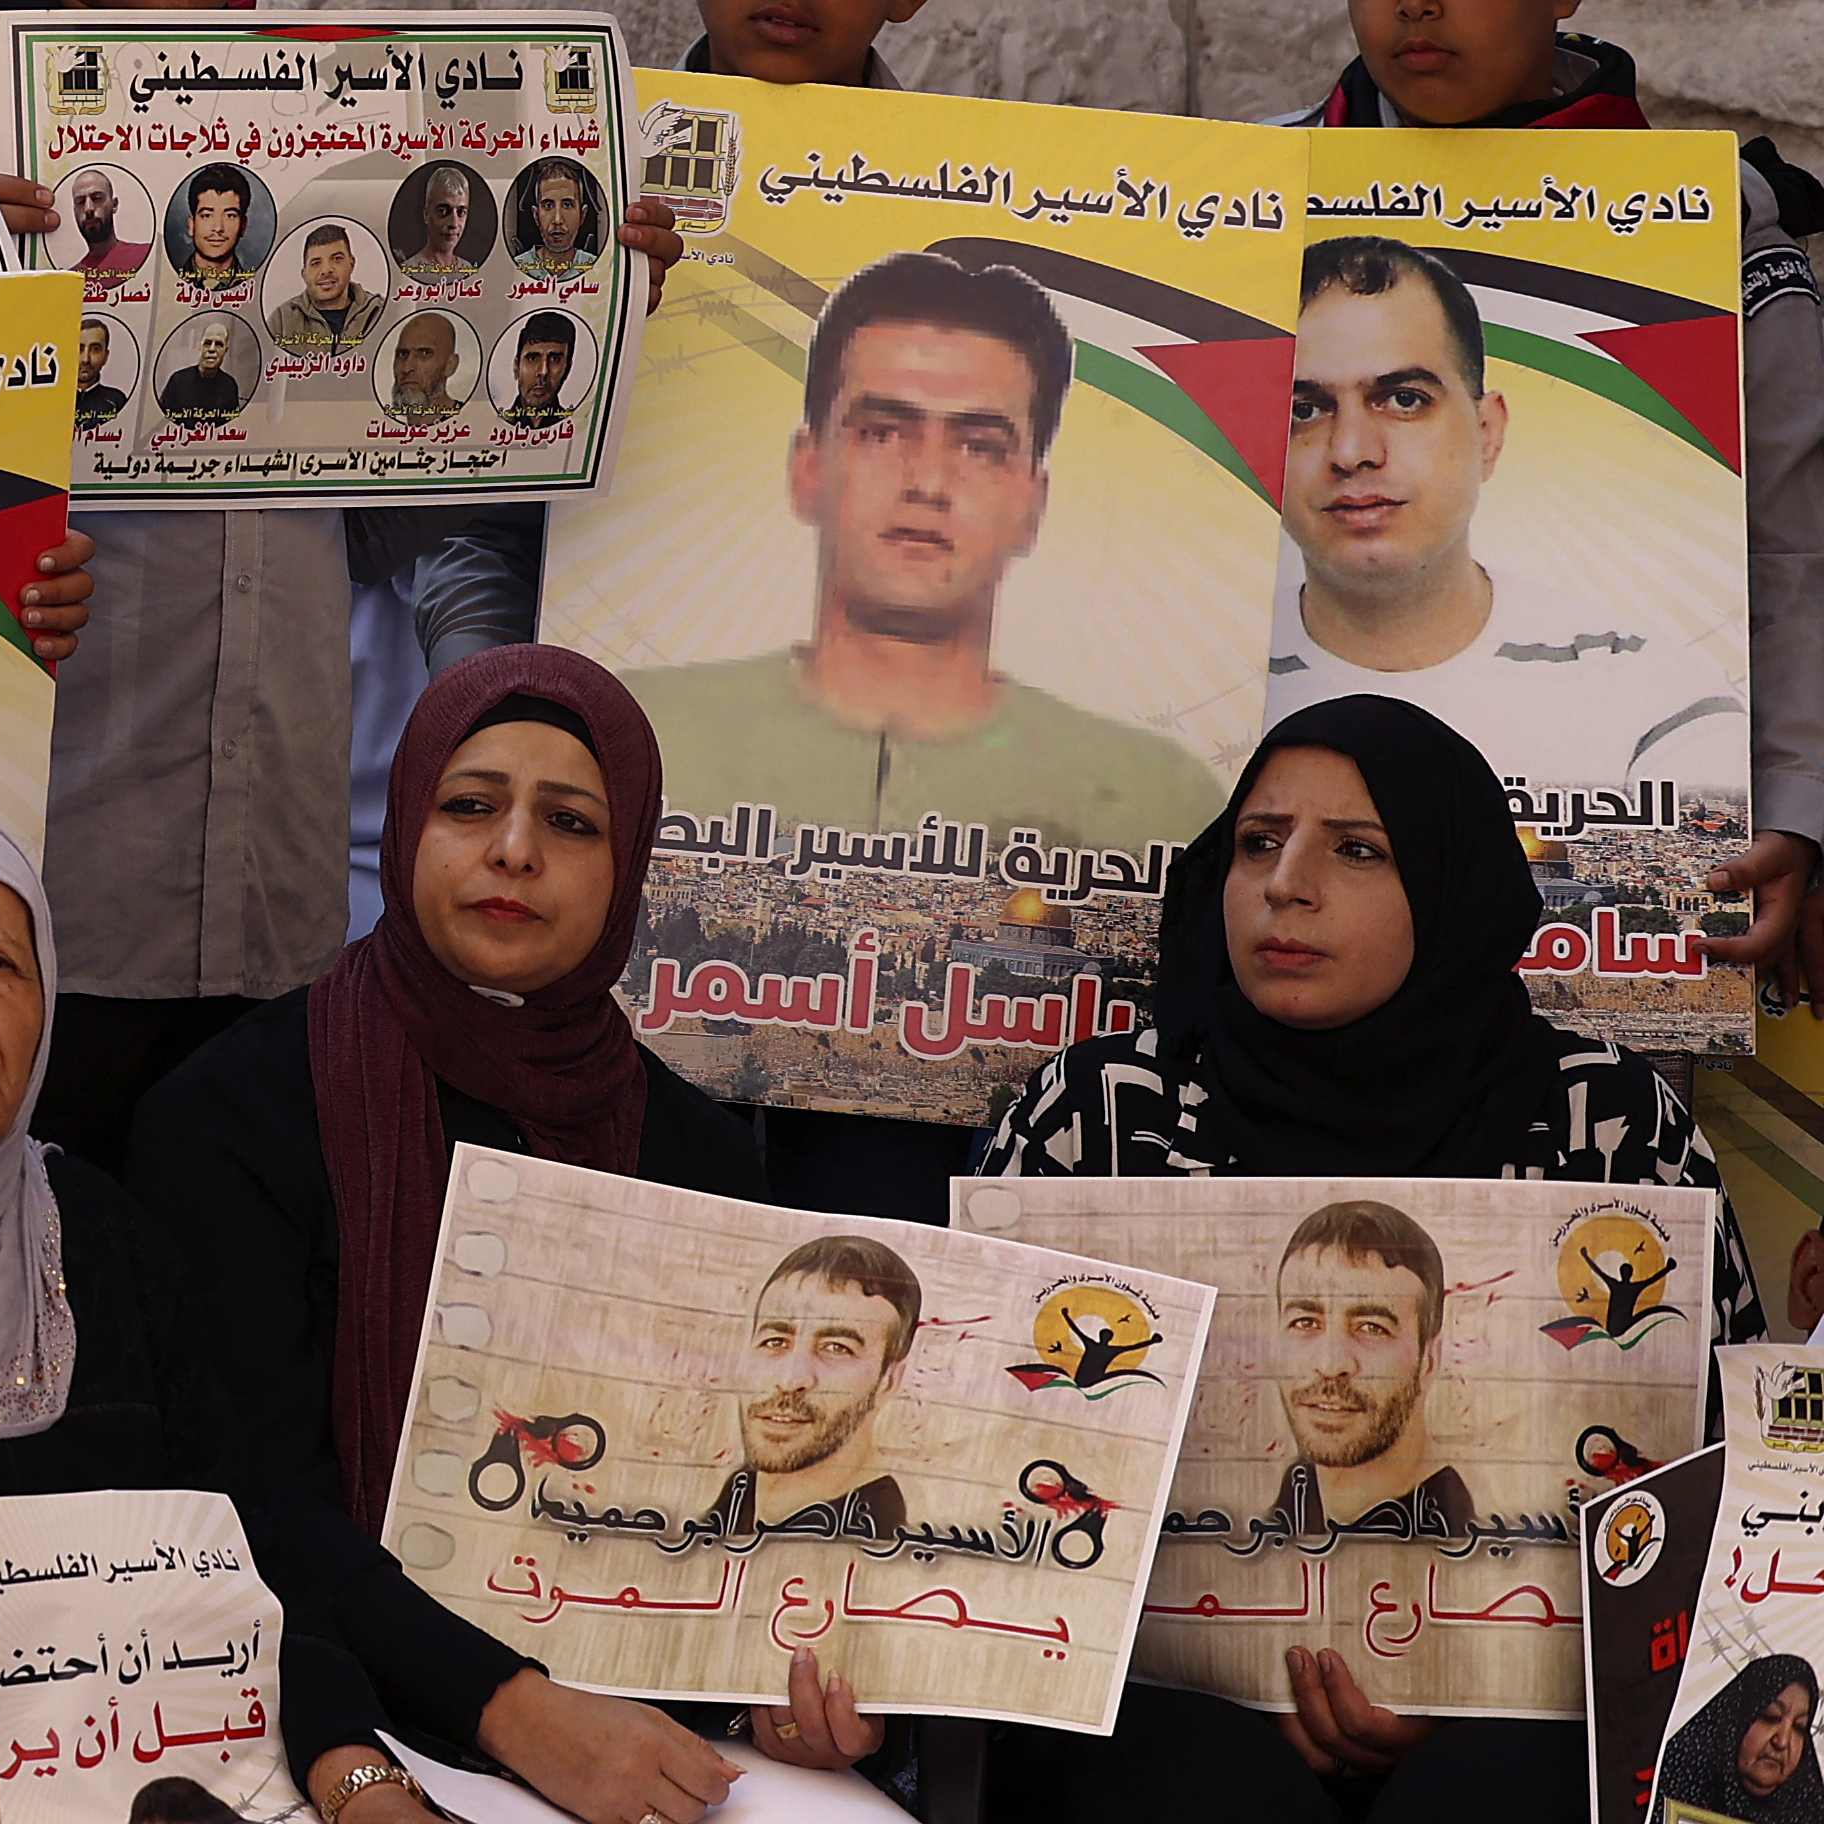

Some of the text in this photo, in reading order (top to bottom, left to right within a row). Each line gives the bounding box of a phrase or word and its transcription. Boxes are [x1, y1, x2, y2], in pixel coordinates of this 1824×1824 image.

[130, 44, 523, 113] نادي الأسير الفلسطيني
[49, 117, 600, 164] شهداء الحركة الأسيرة المحتجزون في ثلاجات الاحتلال
[759, 152, 1286, 239] نادي الأسير الفلسطيني
[1445, 176, 1595, 227] الأسير
[1608, 187, 1711, 234] نادي
[707, 254, 734, 265] نادي
[176, 282, 210, 308] دولة
[447, 280, 483, 301] كمال
[559, 276, 599, 304] سامي
[266, 352, 365, 381] داود الزبيدي
[85, 425, 122, 448] بسام
[217, 426, 247, 441] سعد
[430, 420, 471, 443] عزيز
[490, 420, 574, 446] فارس بارود
[94, 447, 507, 480] احتجاز جثامين الأسرى الشهداء جريمة دولية
[1505, 776, 1674, 836] الحرية
[794, 813, 985, 881] للأسير
[640, 930, 878, 1032] أسمر
[656, 1471, 750, 1555] أبو
[729, 1490, 880, 1554] ناصر
[1240, 1462, 1307, 1560] أبو
[1312, 1489, 1451, 1554] ناصر
[1741, 1491, 1824, 1537] بني
[103, 1539, 186, 1584] الأسير
[192, 1546, 240, 1579] نادي
[486, 1555, 1071, 1662] يصارع الموت
[119, 1628, 150, 1686] أن
[162, 1619, 261, 1677] أريد
[75, 1696, 120, 1769] أن
[133, 1686, 267, 1764] قبل
